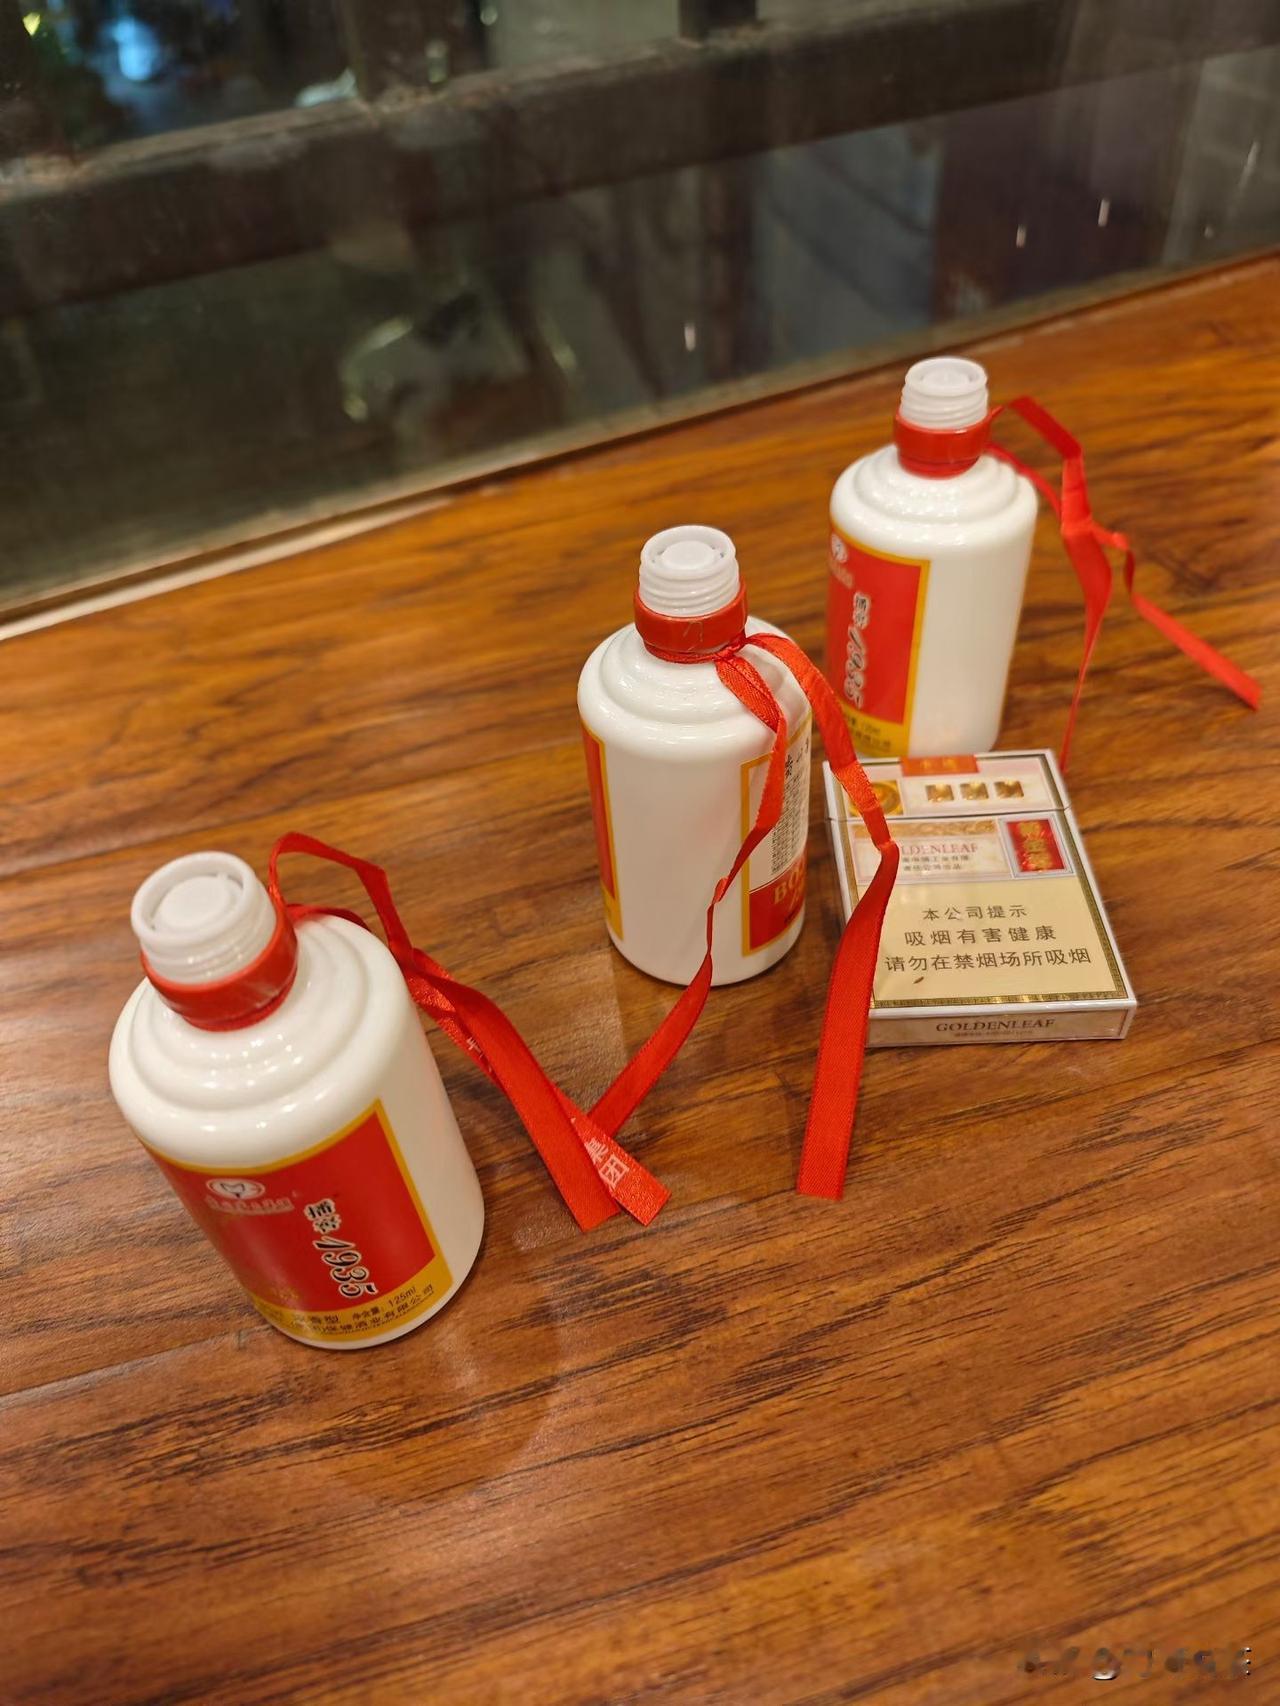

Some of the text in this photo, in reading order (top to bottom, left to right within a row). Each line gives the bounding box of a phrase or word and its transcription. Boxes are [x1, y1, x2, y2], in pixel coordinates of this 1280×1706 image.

[923, 904, 1027, 921] 本公司提示
[904, 925, 1056, 946] 吸烟有害健康
[885, 947, 1092, 972] 请勿在禁烟场所吸烟
[936, 1019, 1056, 1032] GOLDENLEAF
